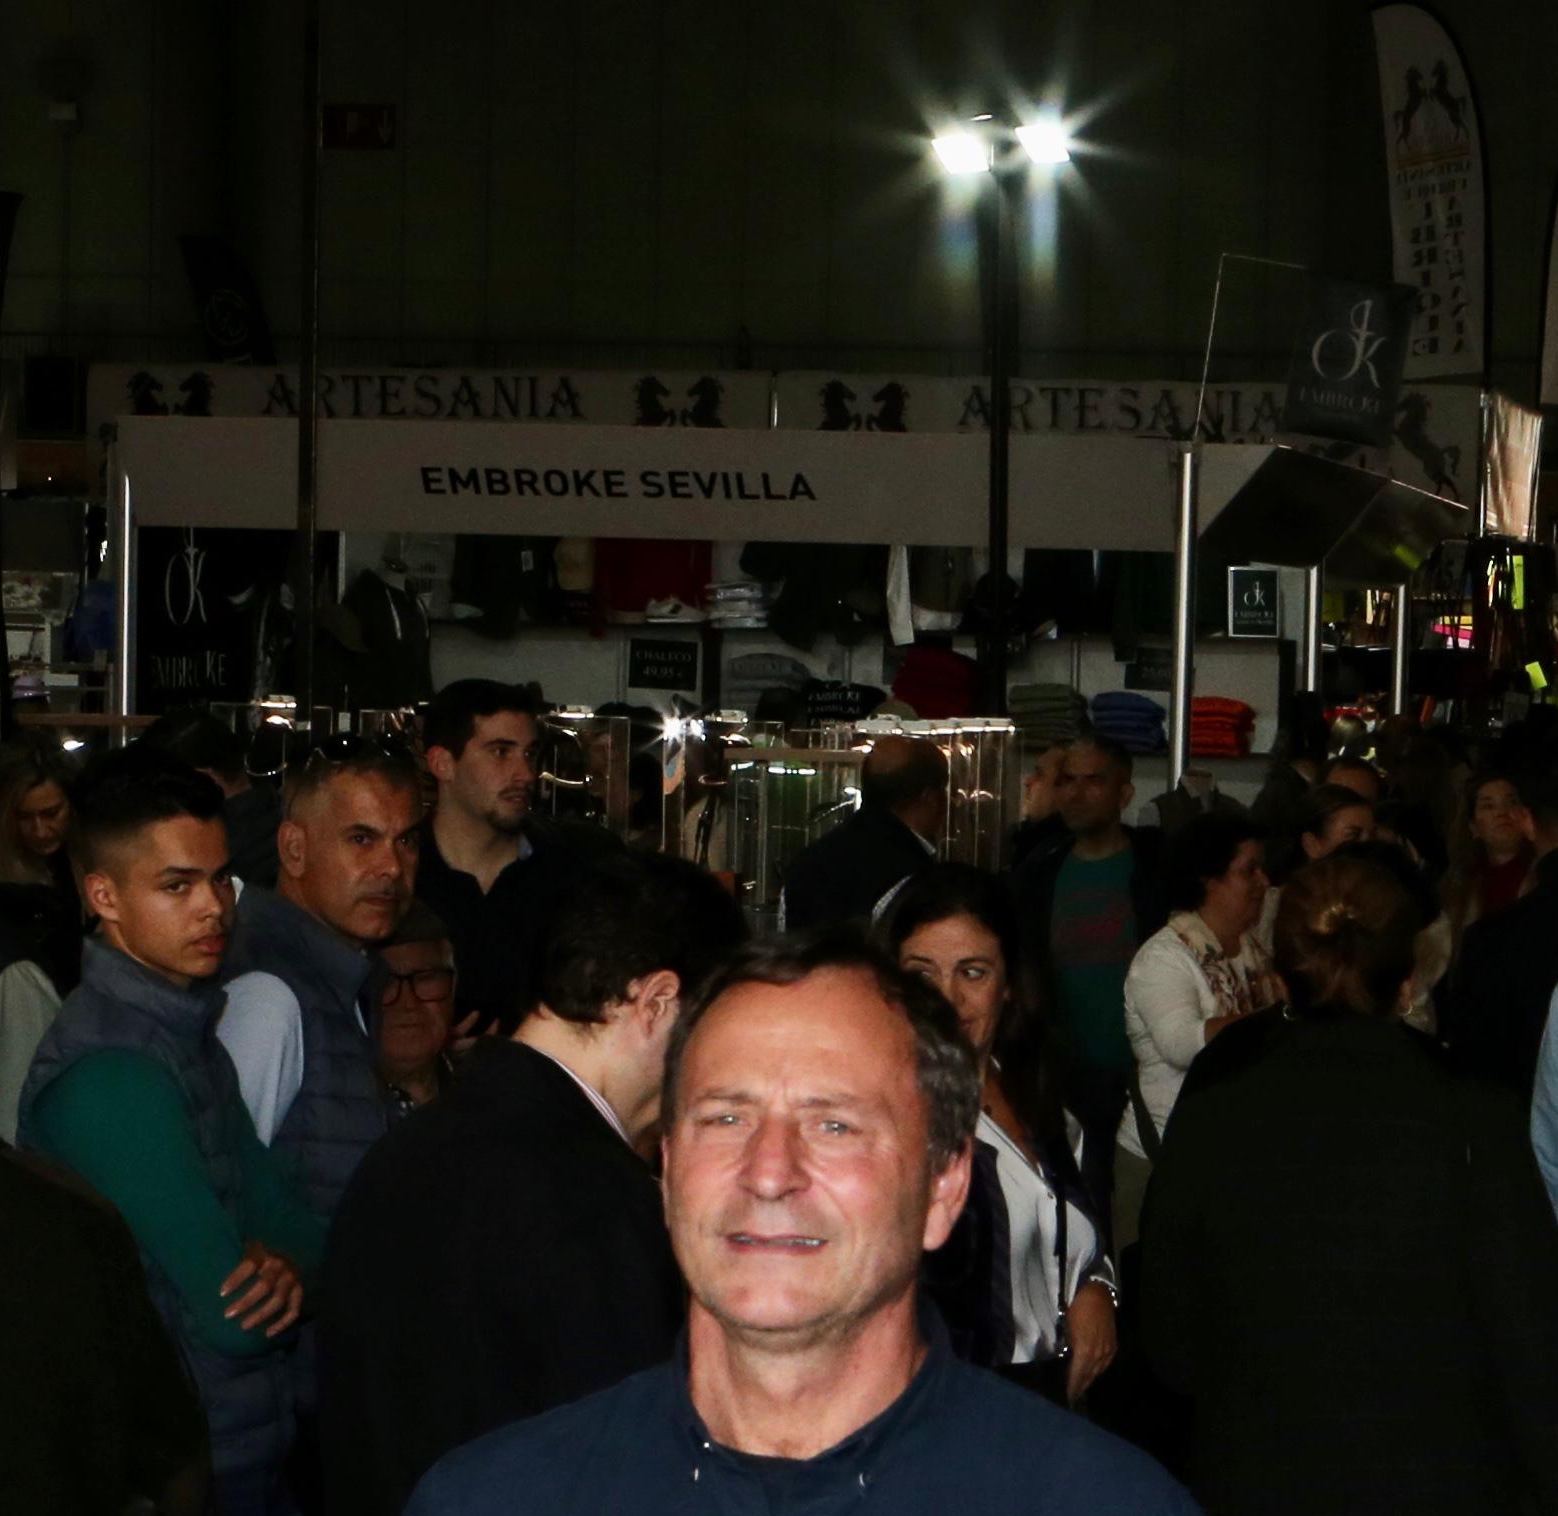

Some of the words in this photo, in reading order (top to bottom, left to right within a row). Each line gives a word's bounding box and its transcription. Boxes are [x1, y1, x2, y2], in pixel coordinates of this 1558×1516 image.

[263, 374, 583, 418] ARTESANIA
[421, 467, 628, 498] EMBROKE
[639, 471, 817, 501] SEVILLA
